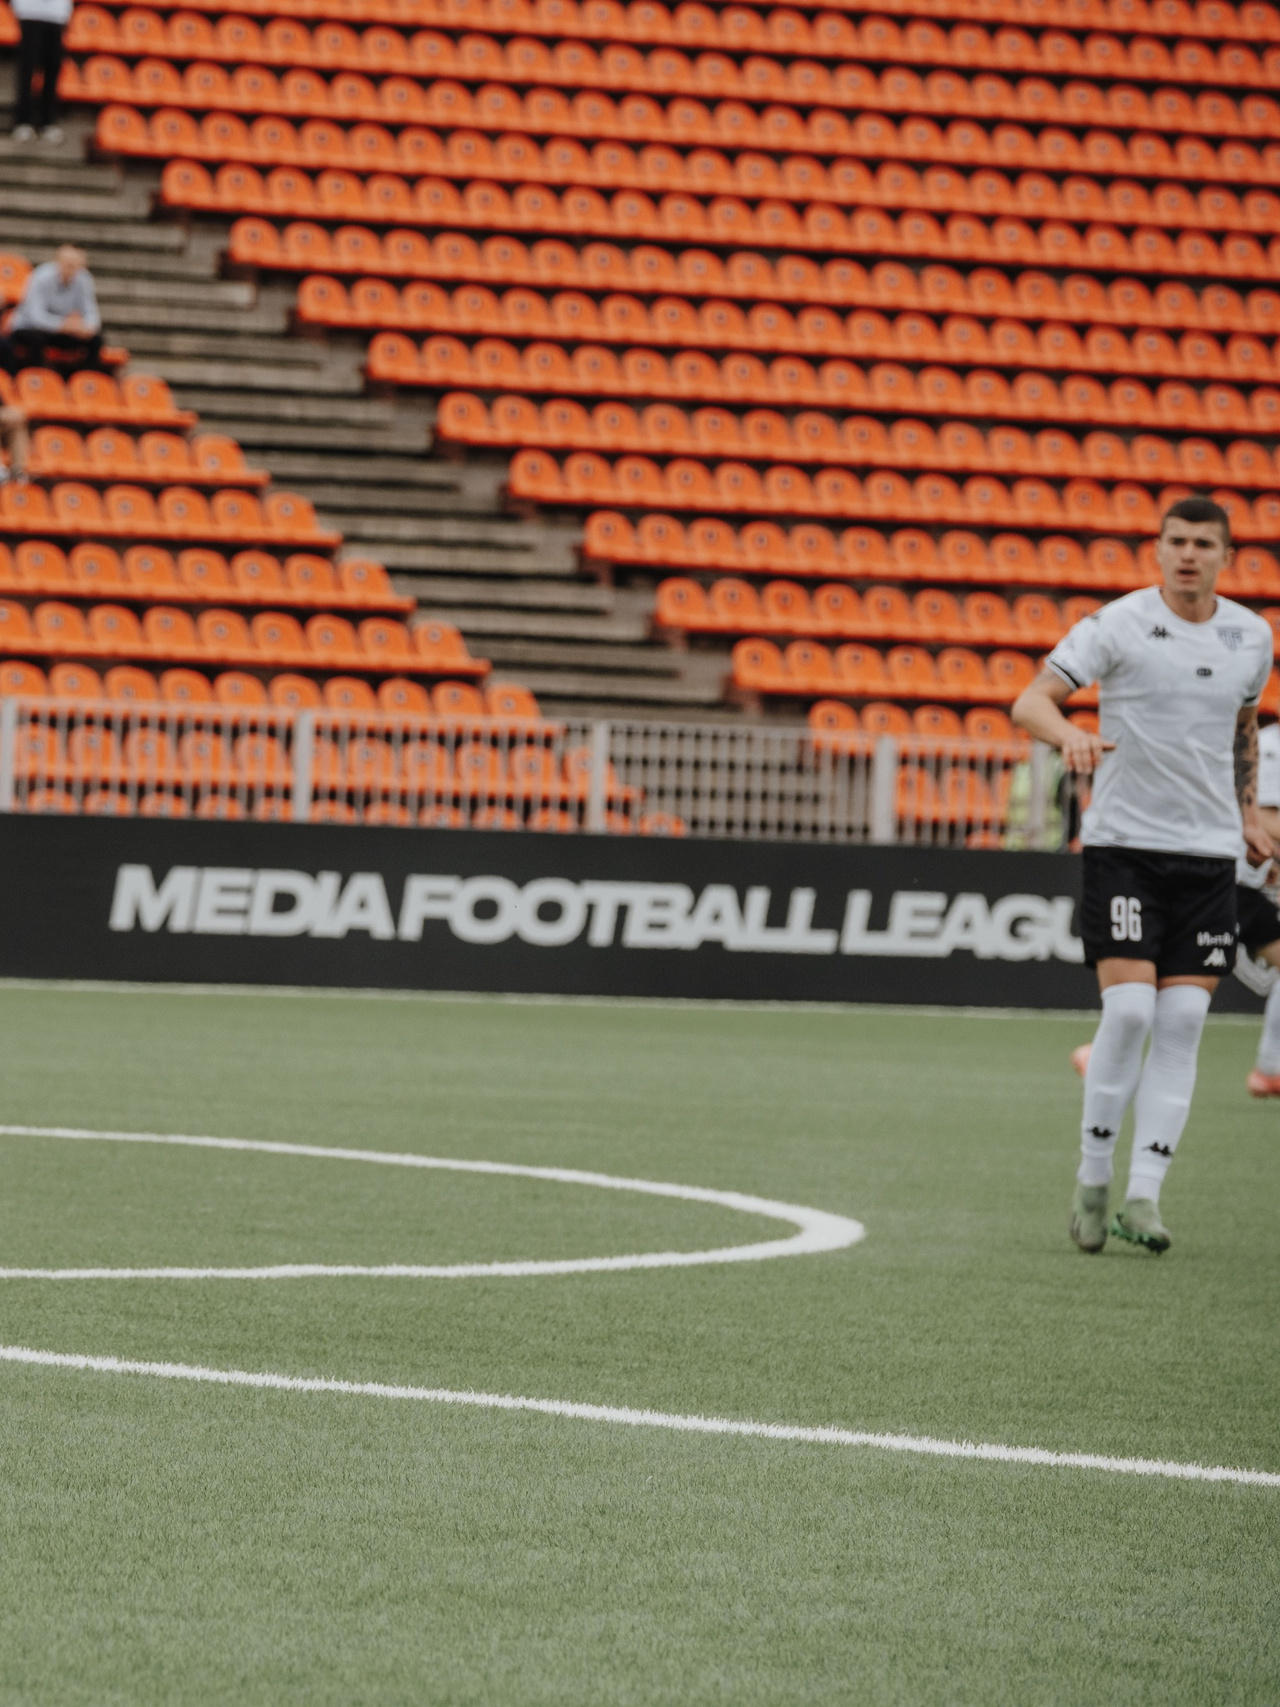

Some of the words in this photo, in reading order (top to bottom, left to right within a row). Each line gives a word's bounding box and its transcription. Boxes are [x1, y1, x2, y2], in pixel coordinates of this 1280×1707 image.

[109, 863, 396, 941] MEDIA
[397, 873, 838, 955] FOOTBALL
[840, 888, 1085, 963] LEAGU
[1110, 895, 1142, 942] 96
